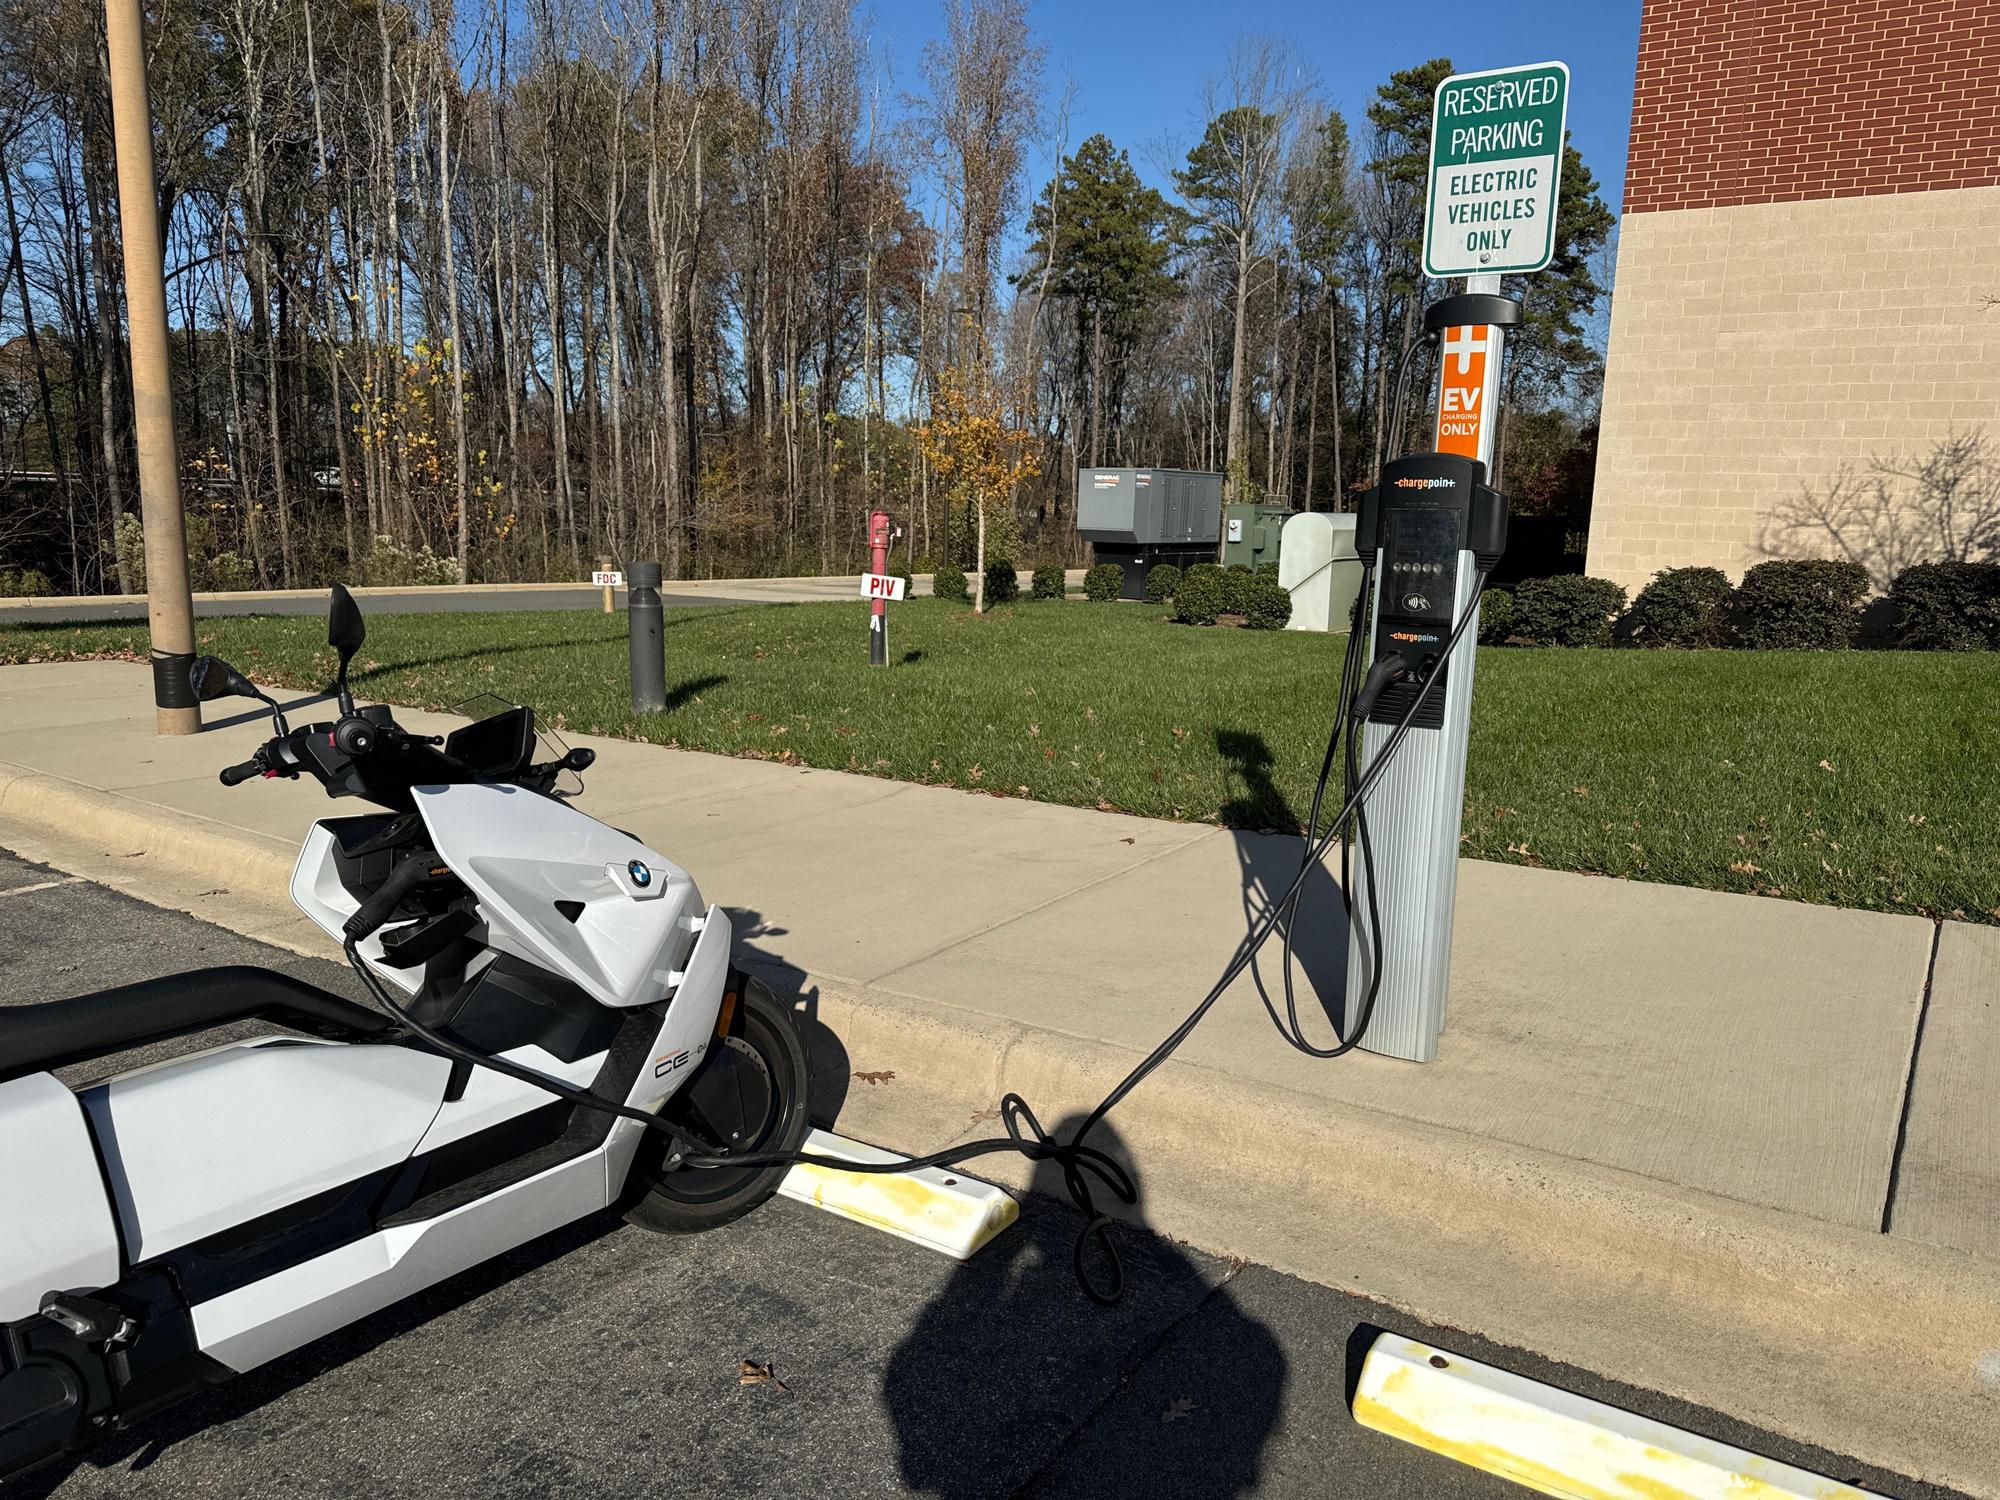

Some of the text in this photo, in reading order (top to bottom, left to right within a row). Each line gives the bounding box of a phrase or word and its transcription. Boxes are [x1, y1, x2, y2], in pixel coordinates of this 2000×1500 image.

[1444, 76, 1558, 117] RESERVED
[1451, 118, 1544, 155] PARKING
[1450, 167, 1538, 196] ELECTRIC
[1448, 197, 1536, 225] VEHICLES
[1466, 228, 1512, 251] ONLY
[1443, 387, 1481, 411] EV
[1442, 413, 1478, 421] CHARGING
[1441, 422, 1478, 436] ONLY
[597, 573, 617, 585] FDC
[870, 577, 896, 597] PIV
